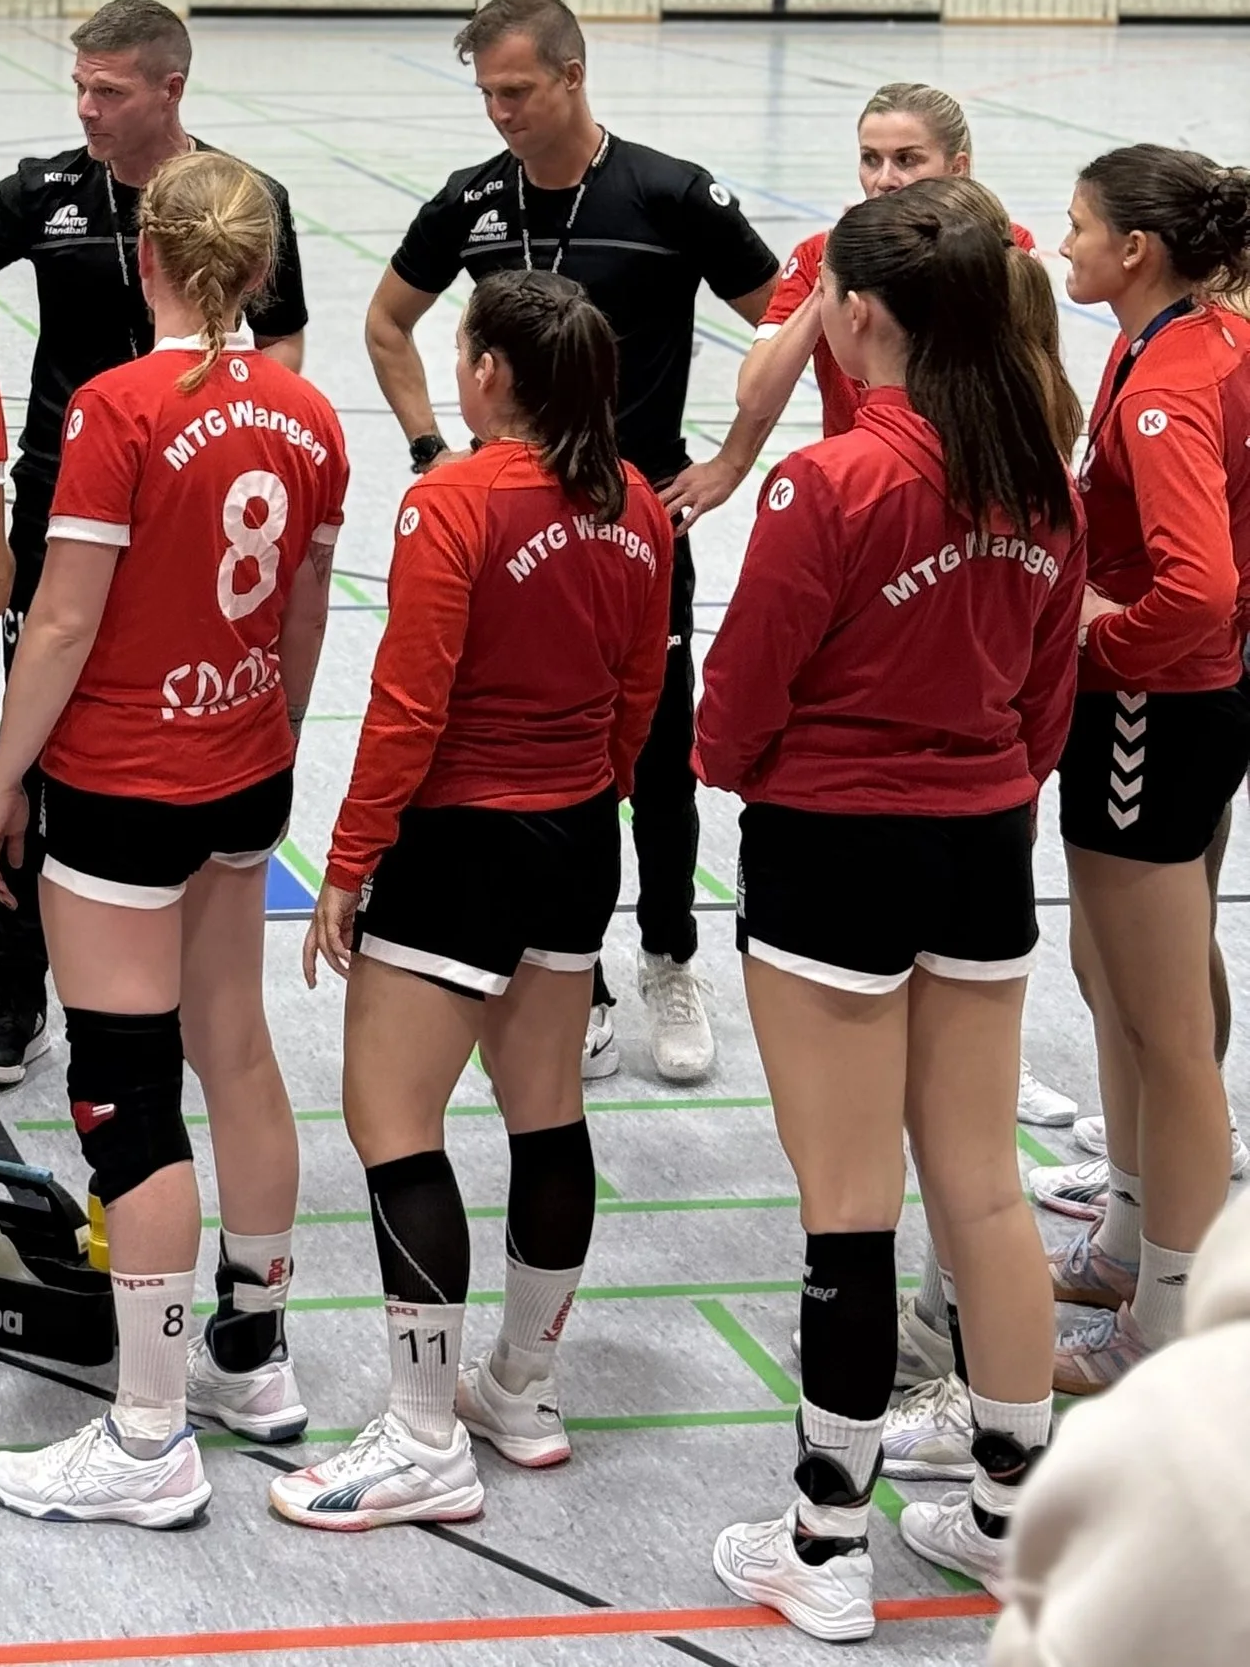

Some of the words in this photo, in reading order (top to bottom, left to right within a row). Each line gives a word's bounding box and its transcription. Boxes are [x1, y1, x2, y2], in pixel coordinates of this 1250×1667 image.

[464, 179, 504, 203] Kepa
[163, 408, 228, 472] MTG
[226, 400, 328, 467] Wangen
[216, 469, 289, 622] 8
[505, 521, 569, 584] MTG
[572, 514, 657, 578] Wangen
[881, 543, 961, 607] MTG
[112, 1277, 165, 1291] mpa
[162, 1304, 184, 1337] 8
[398, 1328, 447, 1365] 11
